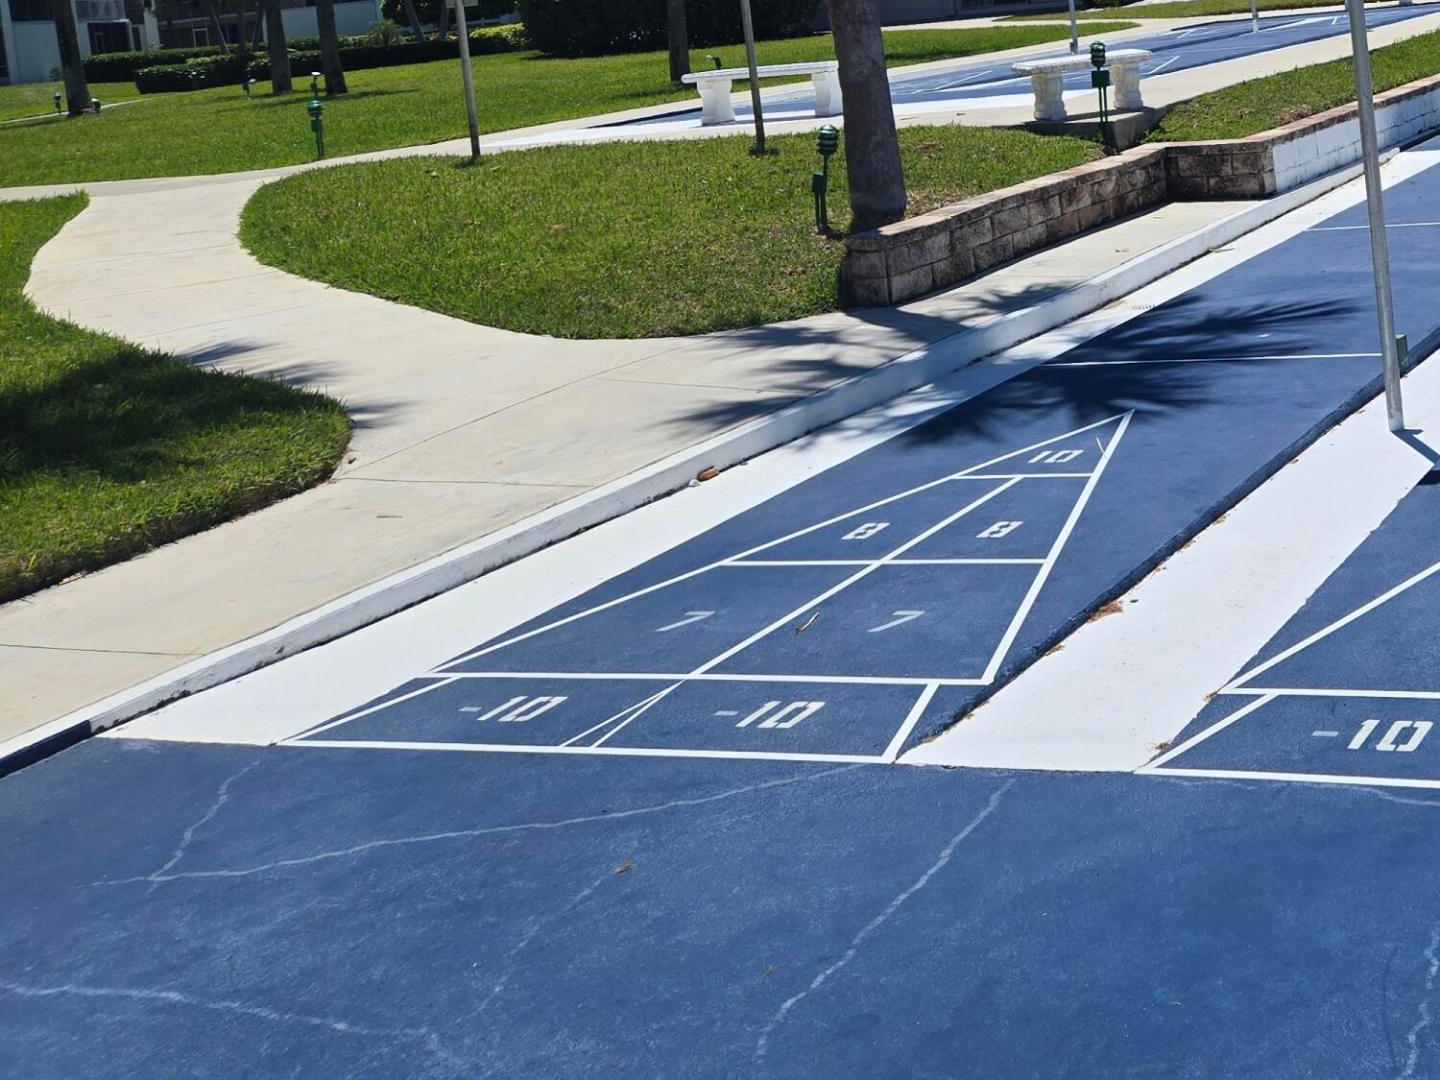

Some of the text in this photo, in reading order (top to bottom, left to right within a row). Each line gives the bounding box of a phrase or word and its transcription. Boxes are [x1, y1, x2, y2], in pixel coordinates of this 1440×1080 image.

[1028, 449, 1083, 463] 10
[841, 522, 890, 540] 8
[977, 520, 1023, 539] 8
[656, 610, 715, 632] 7
[867, 609, 925, 633] 7
[459, 696, 569, 722] -10
[715, 700, 826, 729] -10
[1312, 718, 1434, 752] -10
